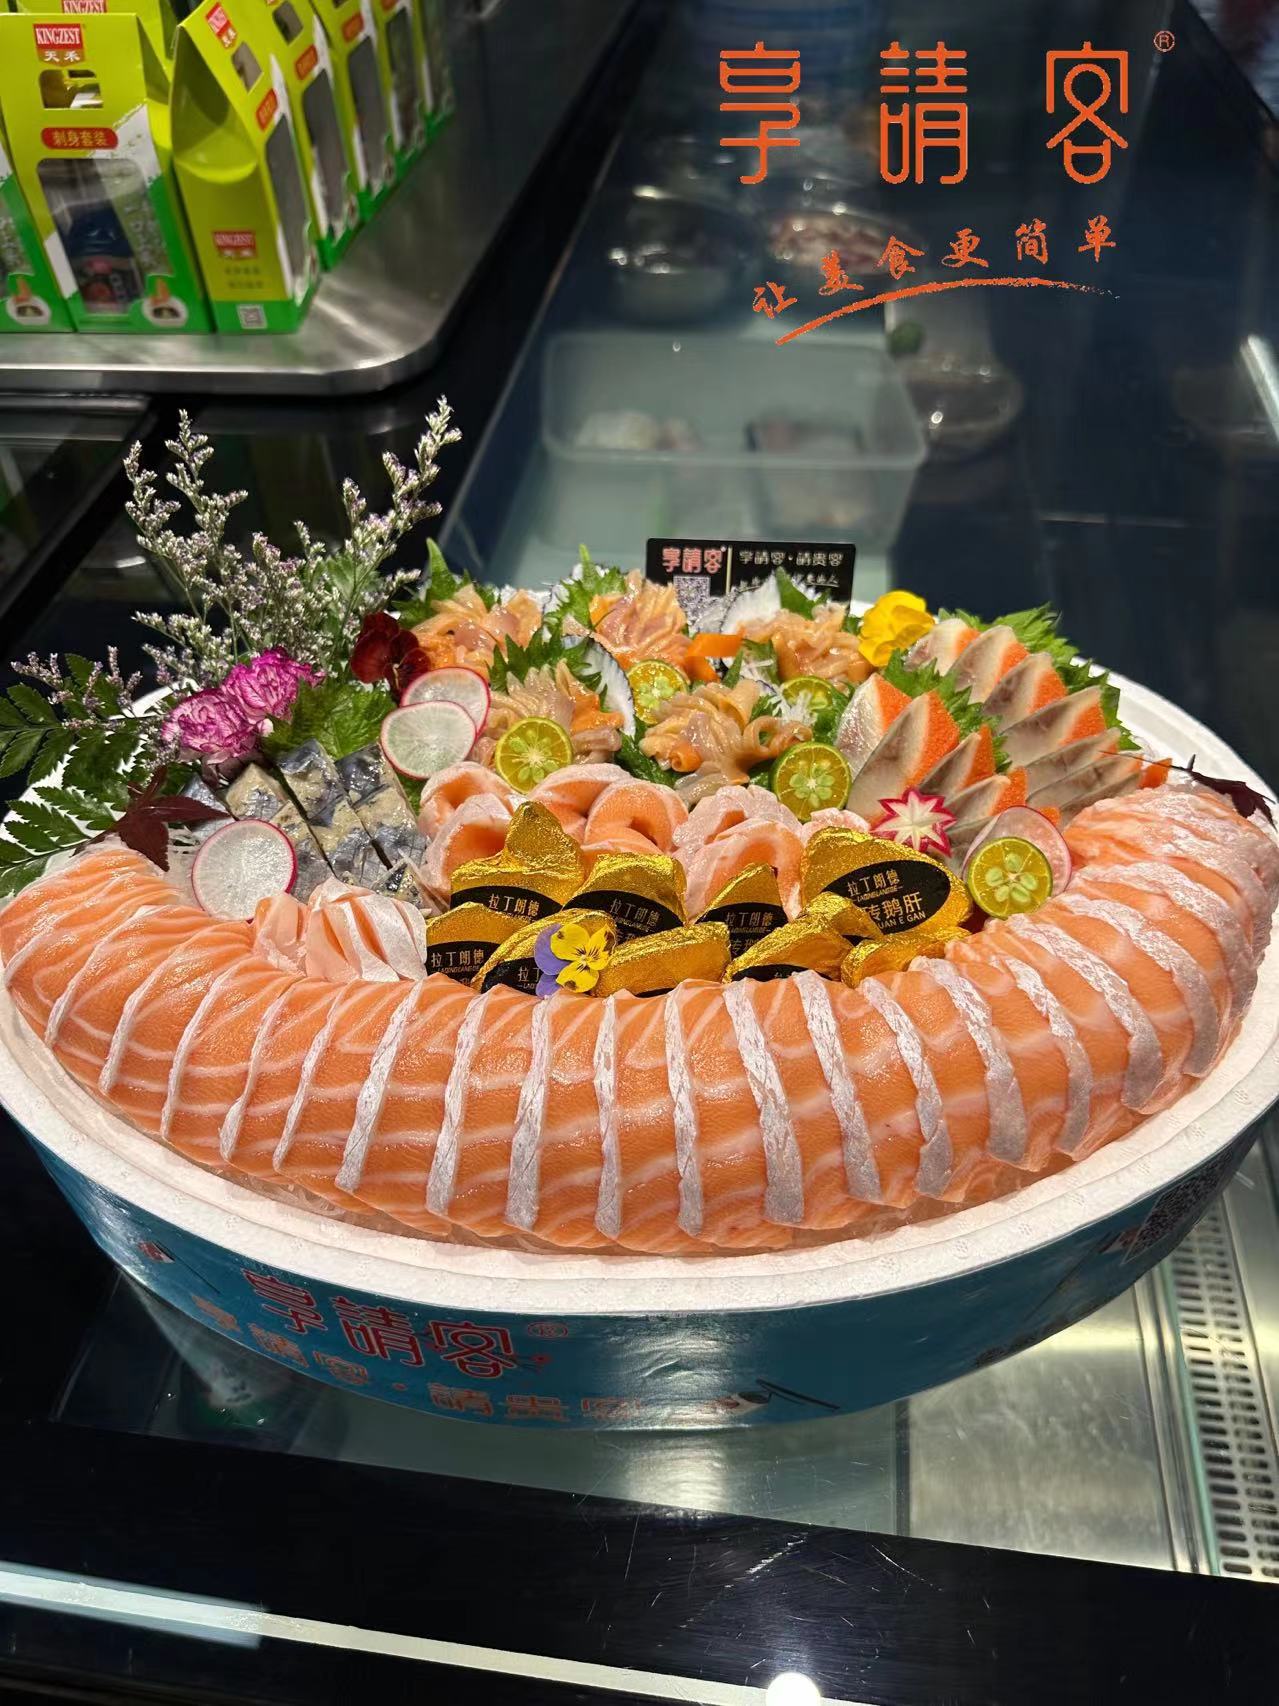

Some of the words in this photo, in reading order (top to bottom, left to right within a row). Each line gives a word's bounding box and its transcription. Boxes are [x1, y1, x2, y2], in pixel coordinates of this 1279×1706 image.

[35, 27, 81, 45] KINGZEST
[847, 868, 900, 898] 拉丁朗德
[488, 893, 540, 917] 拉丁朗德
[608, 898, 661, 928] 拉丁朗德
[724, 911, 774, 927] 拉丁朗德
[898, 915, 905, 925] E
[906, 911, 927, 923] GAN
[431, 948, 485, 968] 拉丁朗德
